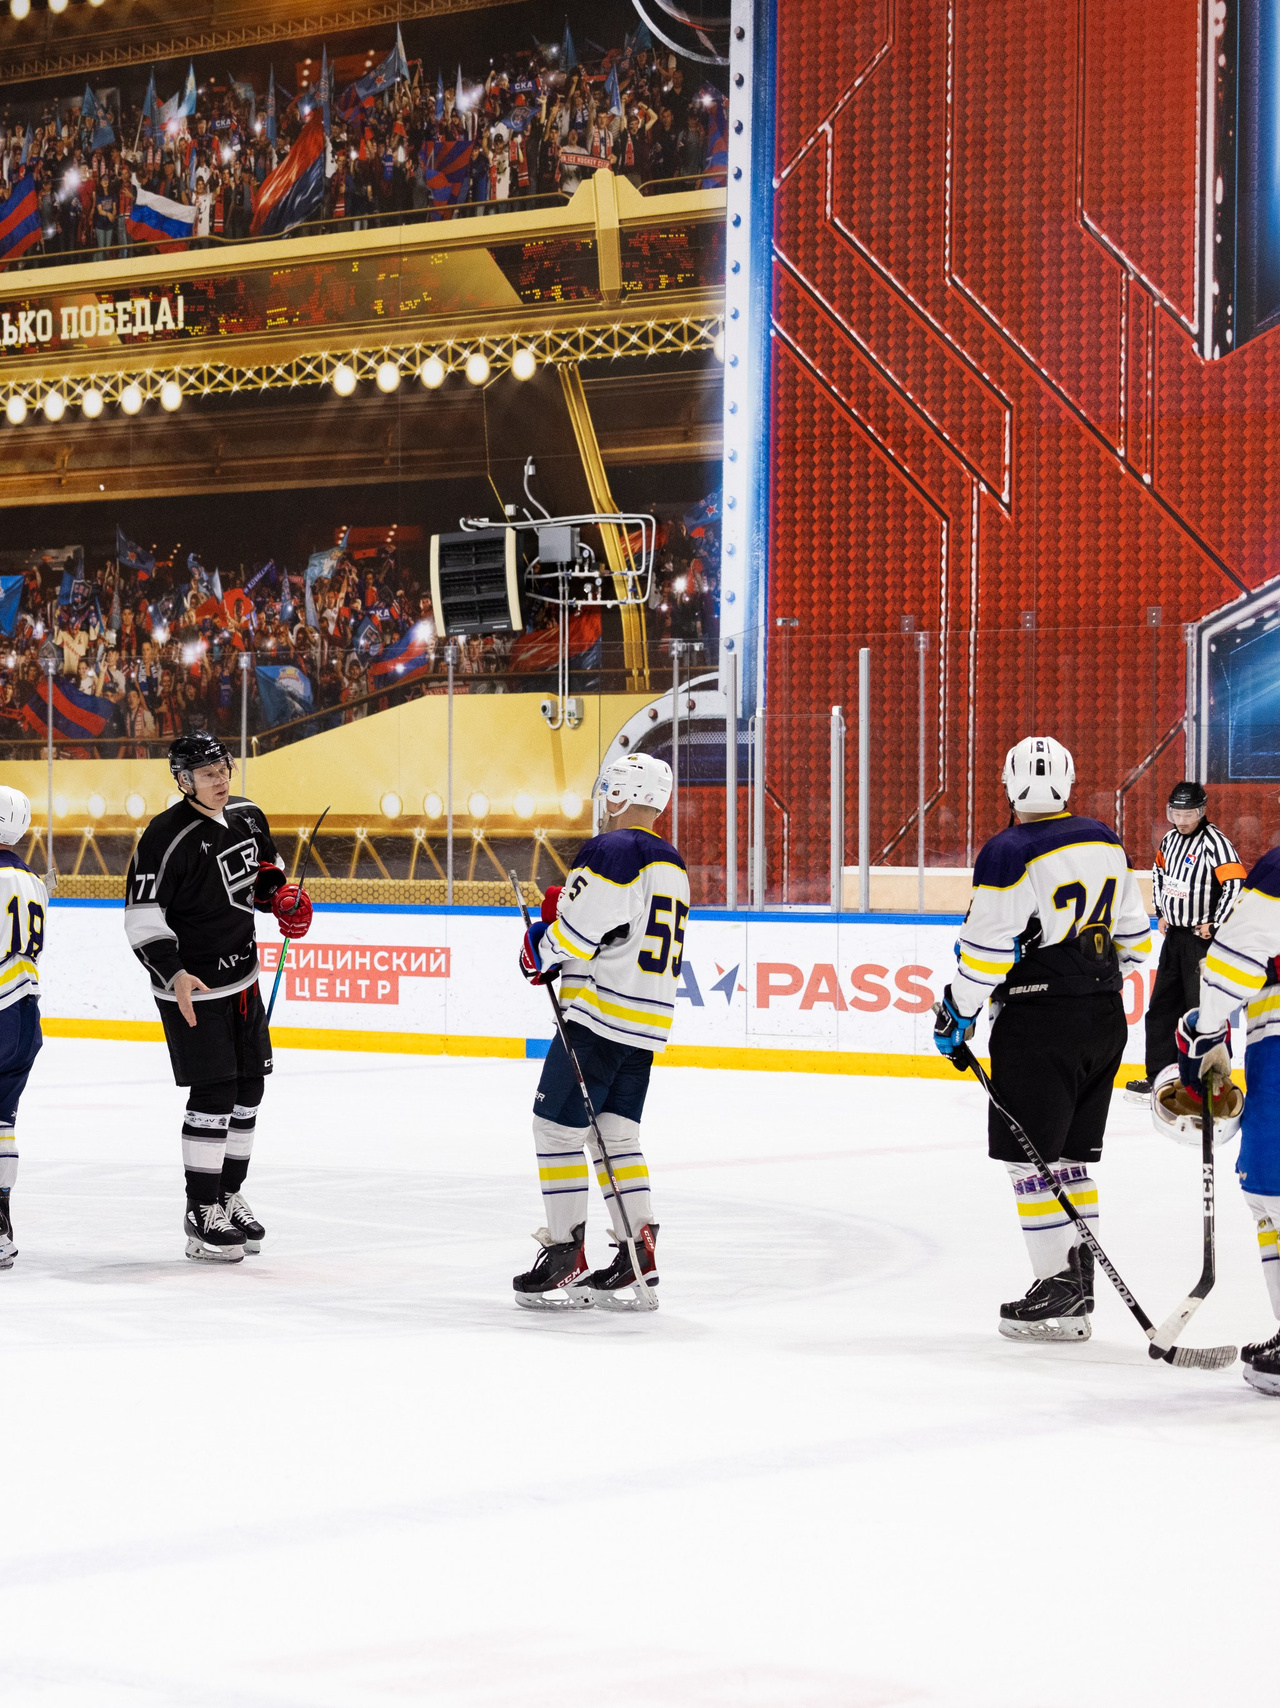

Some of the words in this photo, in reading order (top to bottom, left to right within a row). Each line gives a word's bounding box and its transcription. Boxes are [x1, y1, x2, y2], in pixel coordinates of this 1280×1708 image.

[60, 295, 184, 340] ПОБЕДА!
[222, 849, 260, 881] LR
[135, 874, 156, 900] 77
[5, 894, 45, 961] 18
[1051, 876, 1118, 943] 24
[637, 893, 690, 979] 55
[257, 948, 447, 973] ЕДИЦИНСКИЙ
[295, 978, 391, 999] ЦЕНТР
[756, 962, 935, 1014] PASS
[1202, 1163, 1214, 1217] CCM
[643, 1230, 655, 1250] CCM
[556, 1267, 581, 1289] CCM
